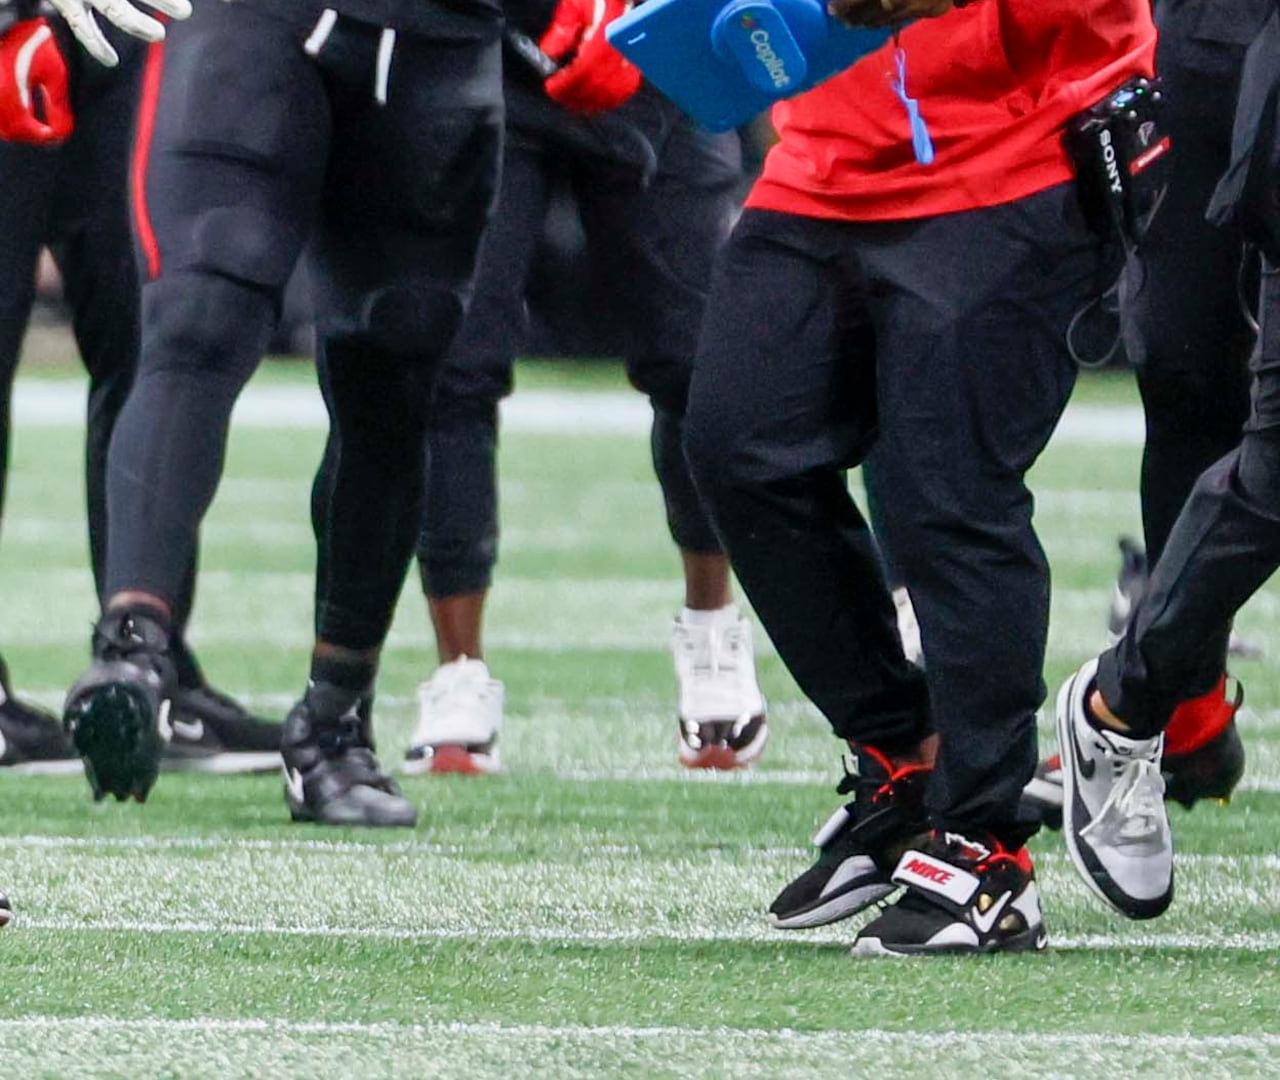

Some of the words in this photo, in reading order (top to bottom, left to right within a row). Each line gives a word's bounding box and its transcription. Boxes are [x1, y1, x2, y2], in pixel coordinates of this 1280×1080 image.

[750, 29, 791, 89] Copilot
[1100, 129, 1122, 193] SONY
[902, 858, 956, 886] NIKE
